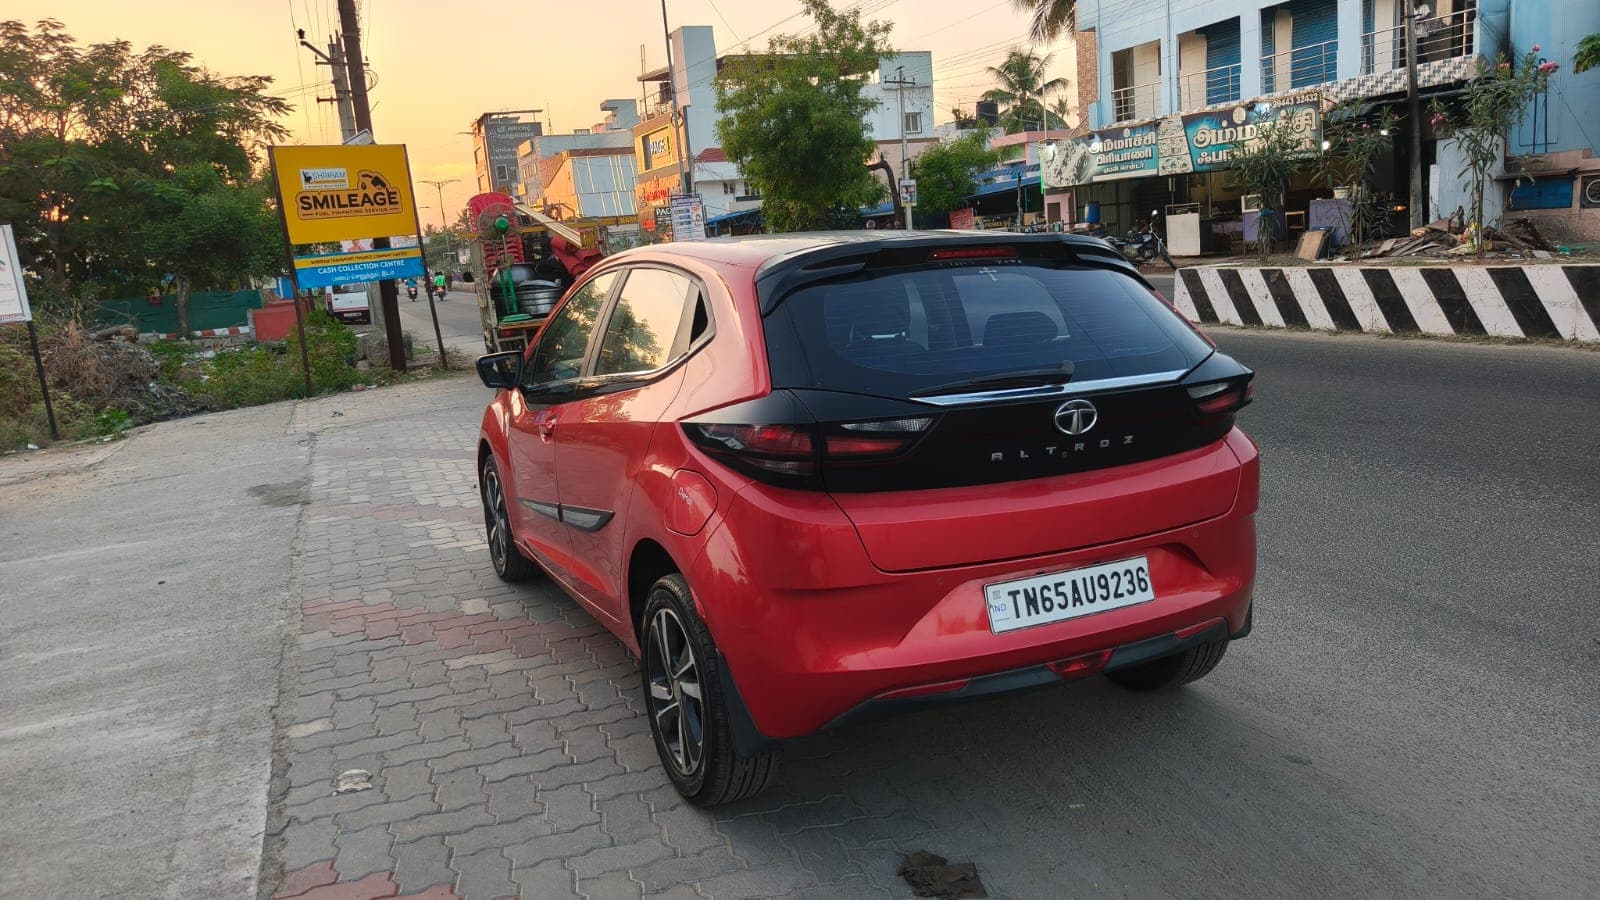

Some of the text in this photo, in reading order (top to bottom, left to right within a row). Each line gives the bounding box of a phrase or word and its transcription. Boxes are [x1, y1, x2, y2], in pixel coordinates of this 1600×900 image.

[1097, 146, 1152, 165] பிரியாணி
[312, 170, 345, 180] SHRIRAM
[299, 191, 399, 210] SMILEAGE
[317, 259, 405, 275] CASH COLLECTION CENTRE
[991, 434, 1134, 461] ALTROZ
[992, 566, 1149, 619] IND TN65AU9236
